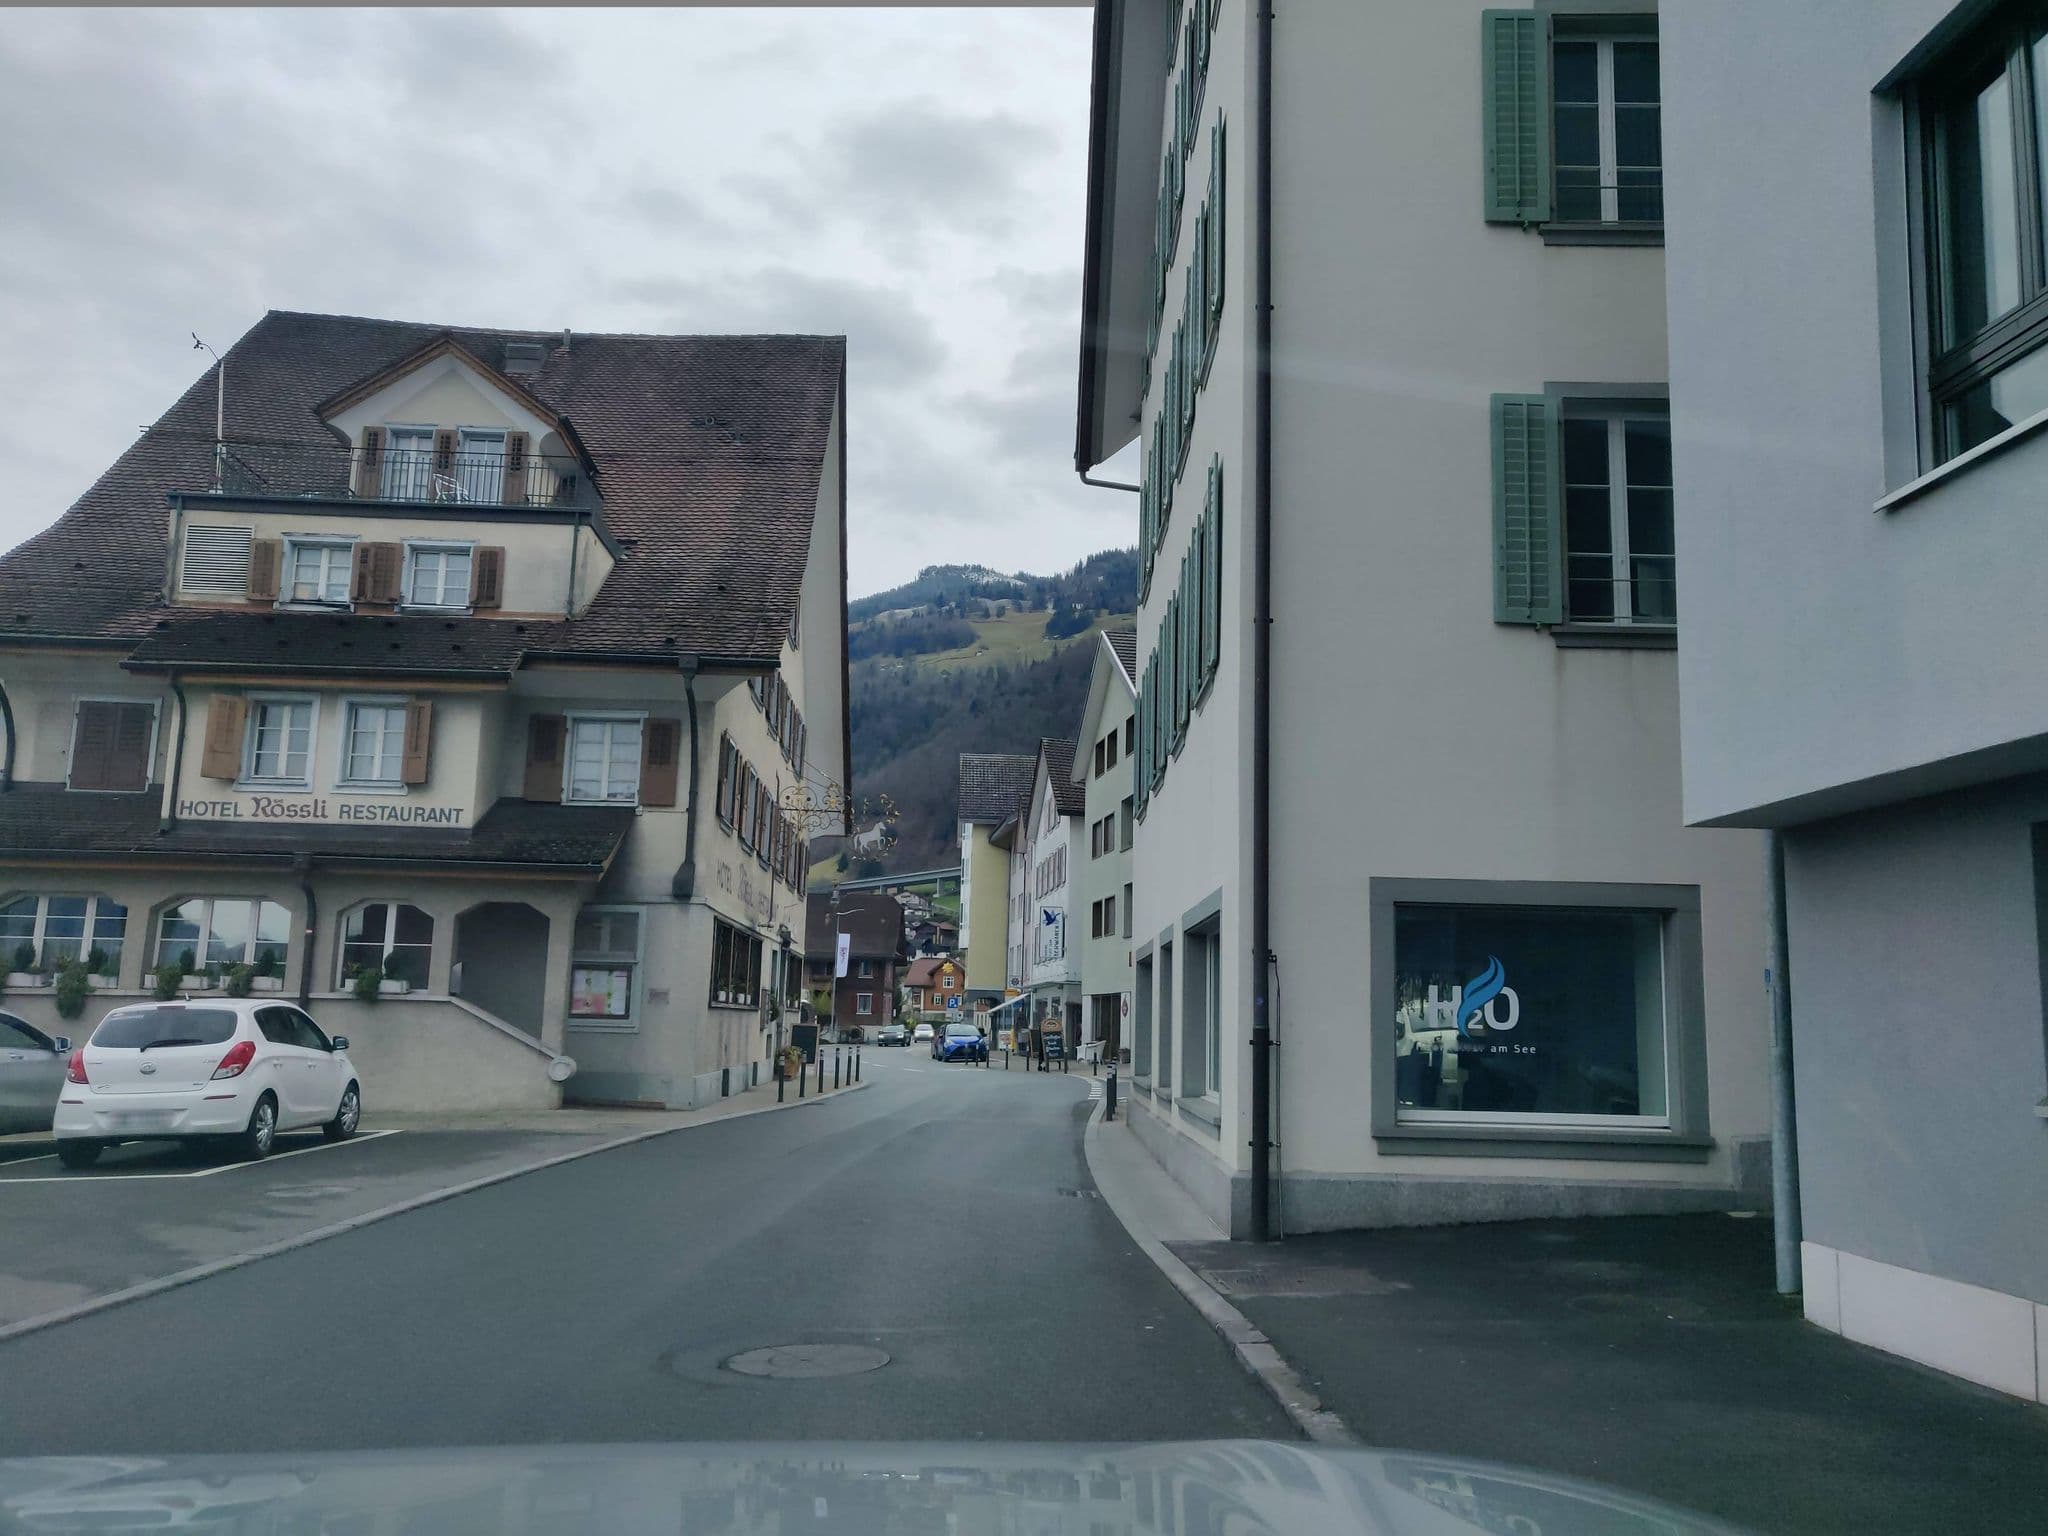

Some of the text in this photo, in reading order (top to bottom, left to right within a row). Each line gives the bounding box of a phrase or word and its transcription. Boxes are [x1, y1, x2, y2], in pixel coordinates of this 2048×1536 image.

[180, 796, 464, 823] HOTEL Rössli RESTAURANT
[1490, 1044, 1508, 1053] am
[1513, 1044, 1537, 1054] See
